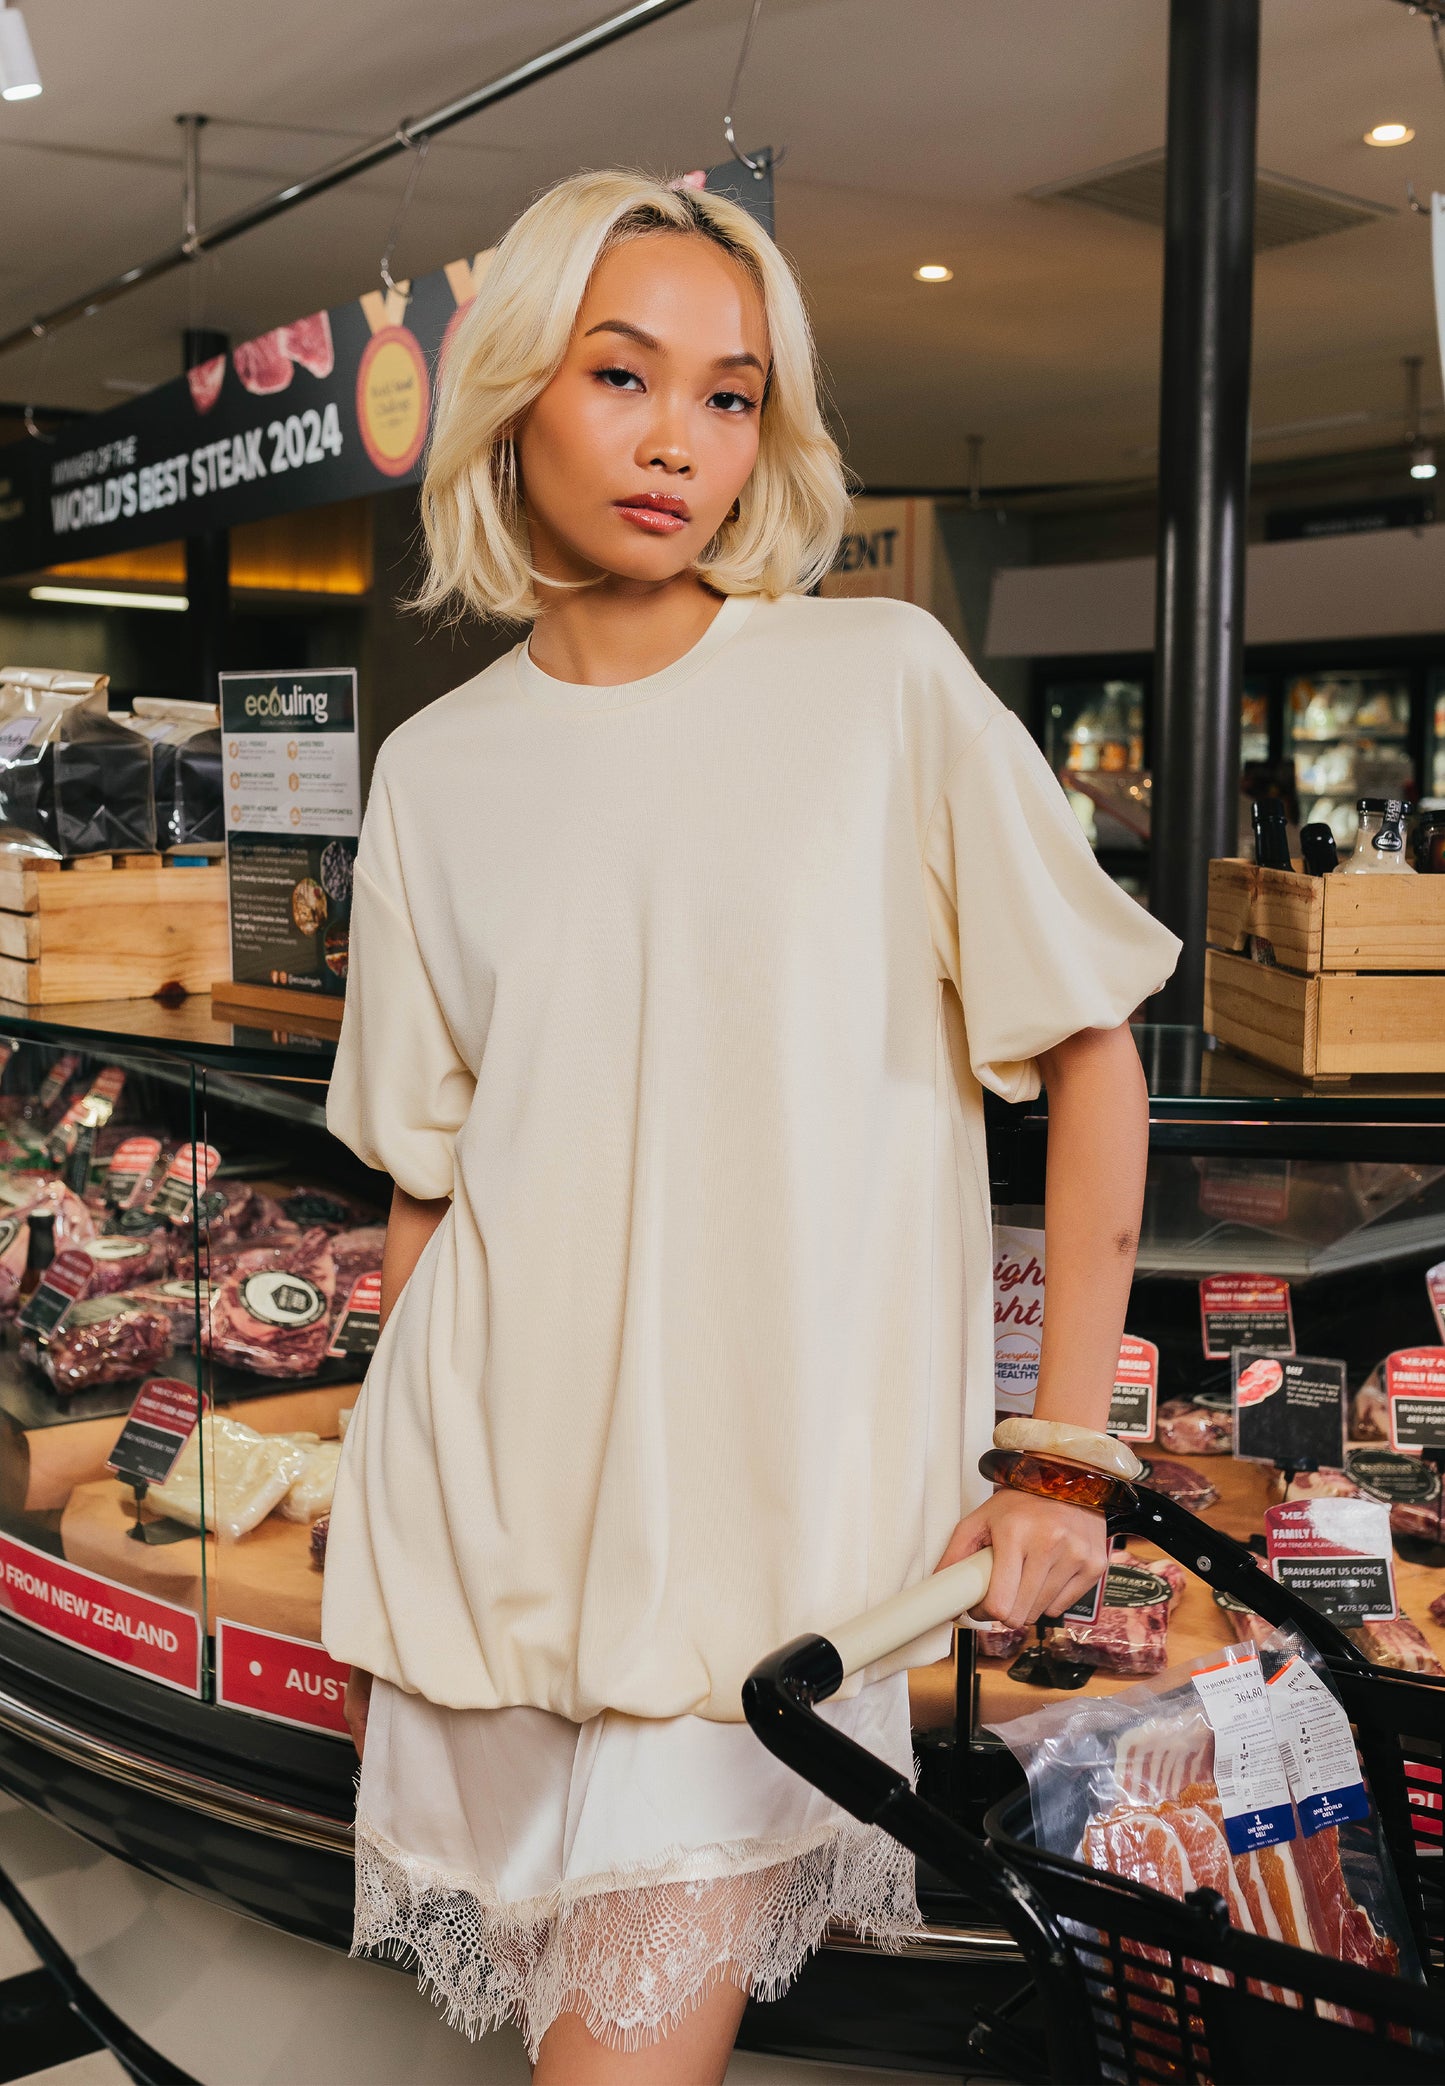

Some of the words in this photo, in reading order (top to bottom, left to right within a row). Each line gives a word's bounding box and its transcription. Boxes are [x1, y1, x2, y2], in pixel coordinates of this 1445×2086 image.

[50, 472, 138, 534] WORLD'S
[139, 453, 190, 513] BEST
[191, 427, 267, 497] STEAK
[267, 402, 344, 474] 2024
[995, 1349, 1039, 1362] Everyday
[1022, 1362, 1039, 1371] AND
[1272, 1528, 1310, 1540] FAMILY
[1282, 1567, 1336, 1576] BRAVEHEART
[1338, 1567, 1350, 1576] US
[1351, 1566, 1383, 1576] CHOICE
[1292, 1580, 1311, 1589] BEEF
[1361, 1578, 1376, 1588] B/L
[6, 1563, 48, 1603] FROM
[51, 1585, 89, 1620] NEW
[92, 1602, 178, 1653] ZEALAND
[1234, 1686, 1263, 1704] 364.80
[1313, 1807, 1323, 1816] ONE
[1323, 1803, 1343, 1812] WORLD
[1321, 1810, 1334, 1818] DELI
[1256, 1823, 1274, 1832] WORLD
[1254, 1831, 1266, 1839] DELI
